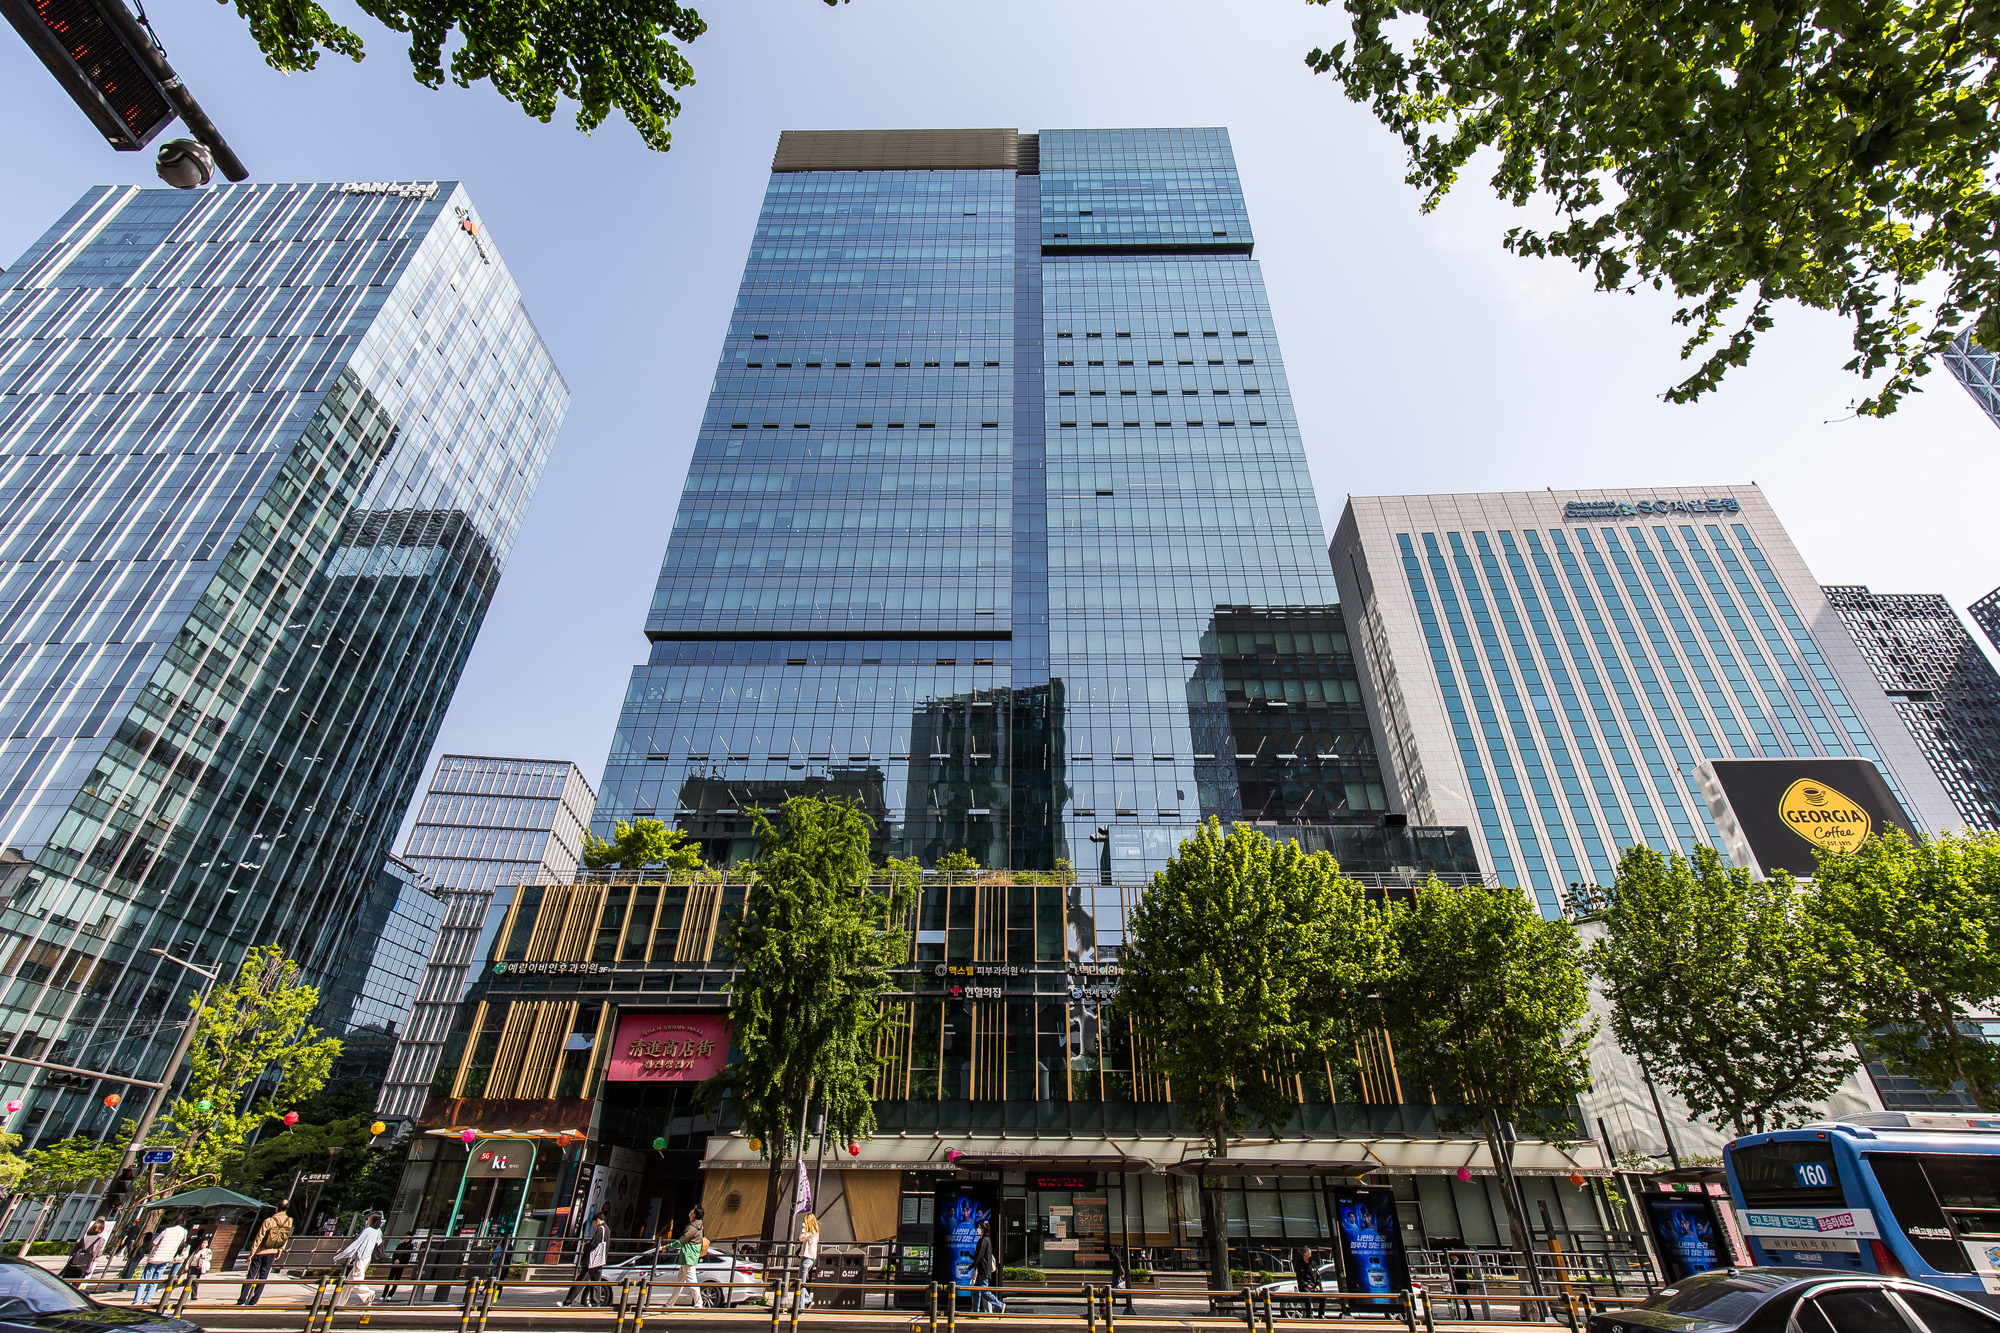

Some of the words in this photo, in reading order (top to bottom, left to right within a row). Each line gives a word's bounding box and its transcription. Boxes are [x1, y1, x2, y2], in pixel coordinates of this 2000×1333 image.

[339, 181, 390, 193] PAN
[1567, 500, 1617, 509] Standard
[1638, 497, 1741, 514] SC제일은행
[1566, 508, 1621, 517] Chartered
[1787, 810, 1865, 823] GEORGIA
[1813, 826, 1855, 839] Coffee
[976, 966, 1018, 976] 피부과의원
[964, 986, 1002, 999] 헌혈의집
[1798, 1164, 1827, 1187] 160
[1077, 1213, 1104, 1222] SPICY
[1818, 1214, 1853, 1230] 환승하세요
[1774, 1239, 1838, 1250] HYUNDAI
